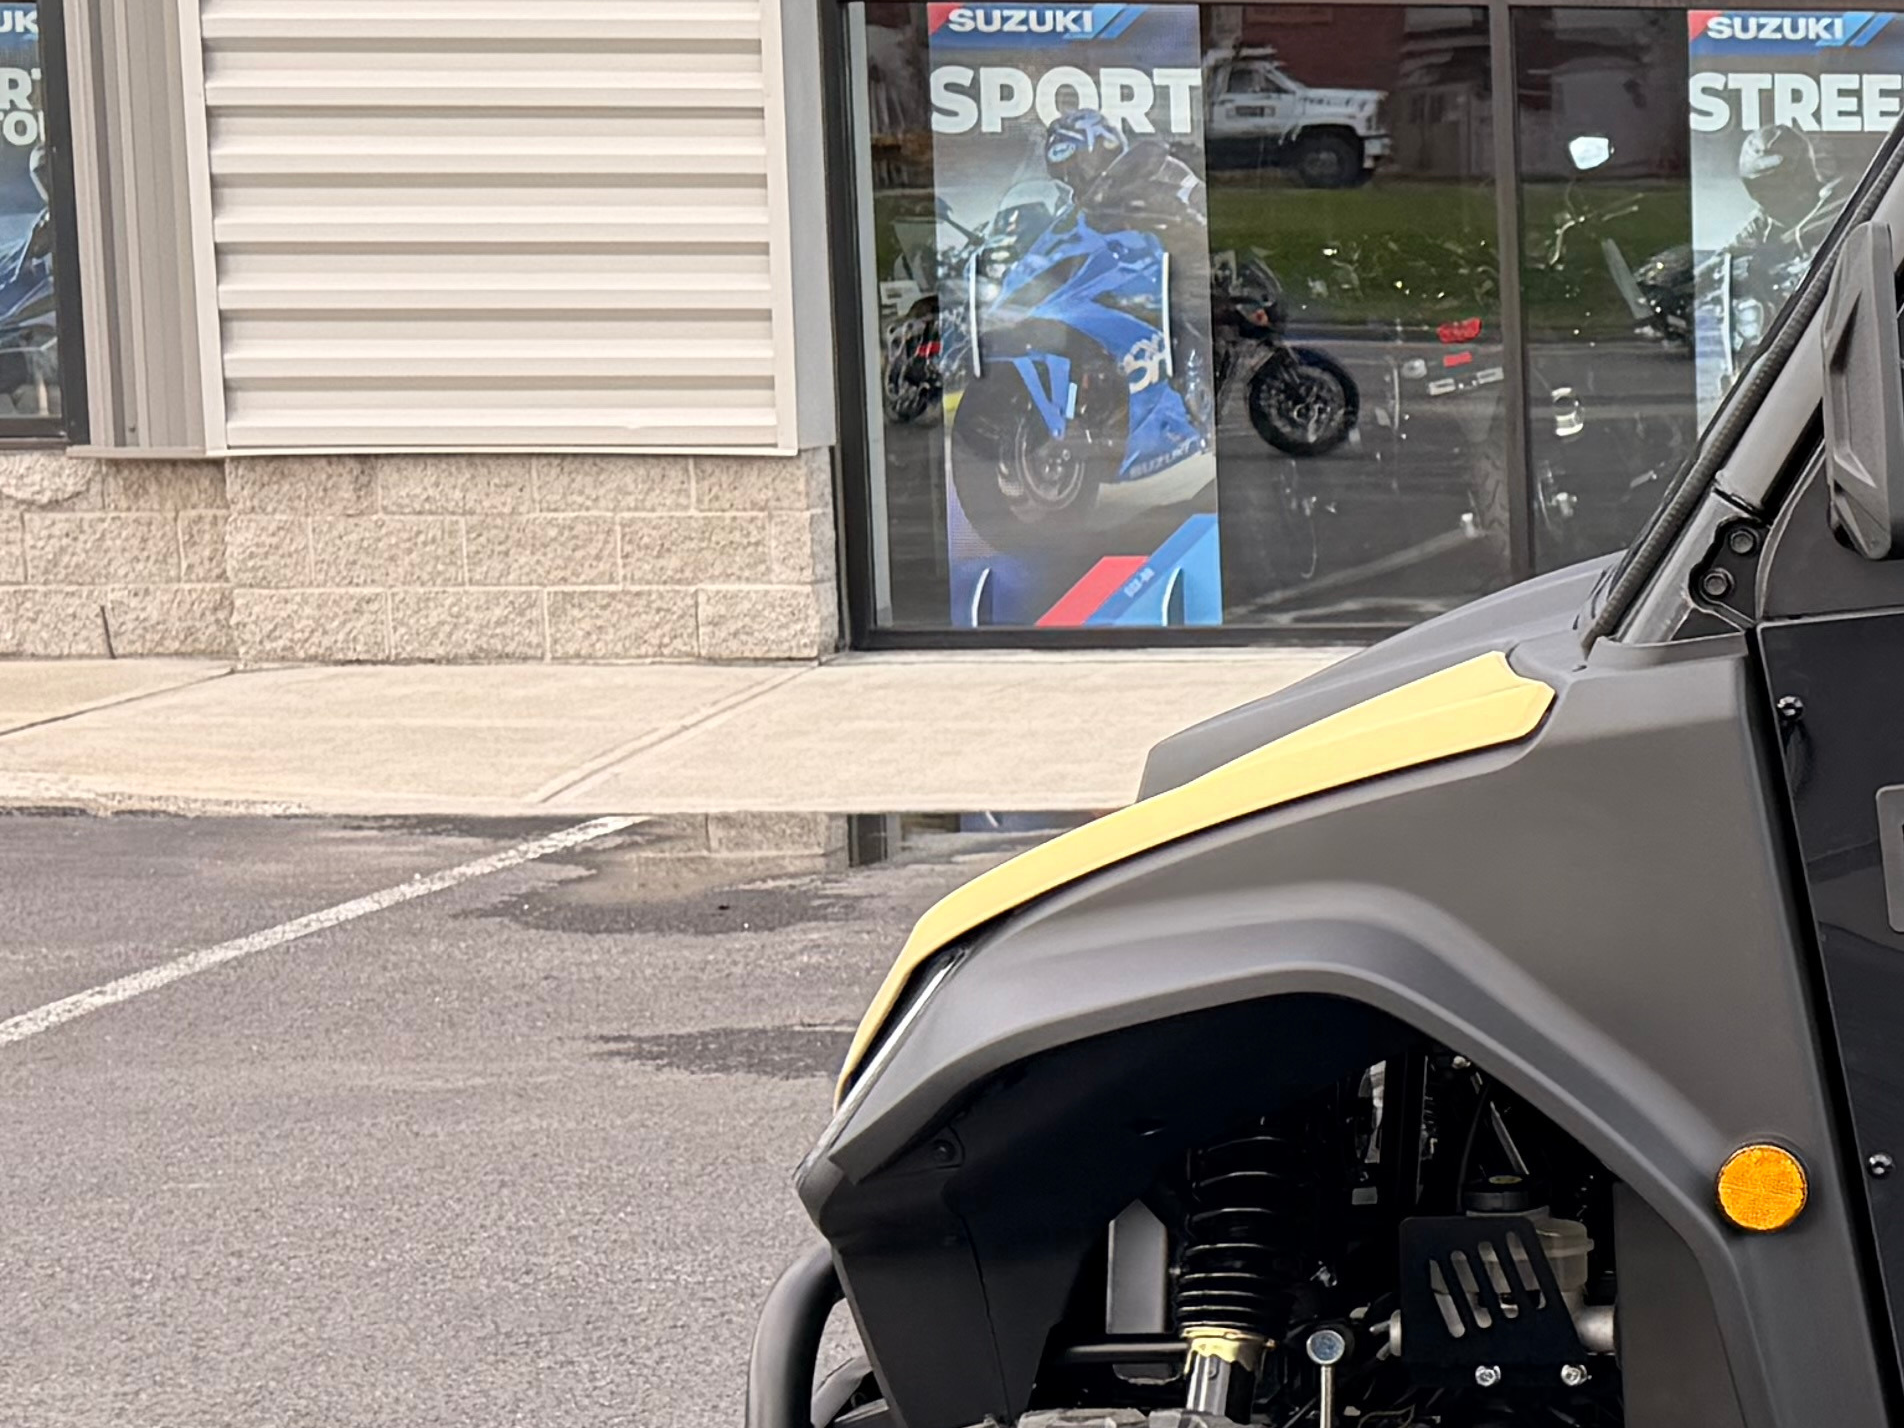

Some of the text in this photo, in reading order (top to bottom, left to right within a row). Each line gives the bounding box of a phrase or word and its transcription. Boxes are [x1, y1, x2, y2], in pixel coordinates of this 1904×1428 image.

[947, 8, 1094, 33] SUZUKI
[1706, 16, 1845, 40] SUZUKI
[930, 65, 1201, 134] SPORT
